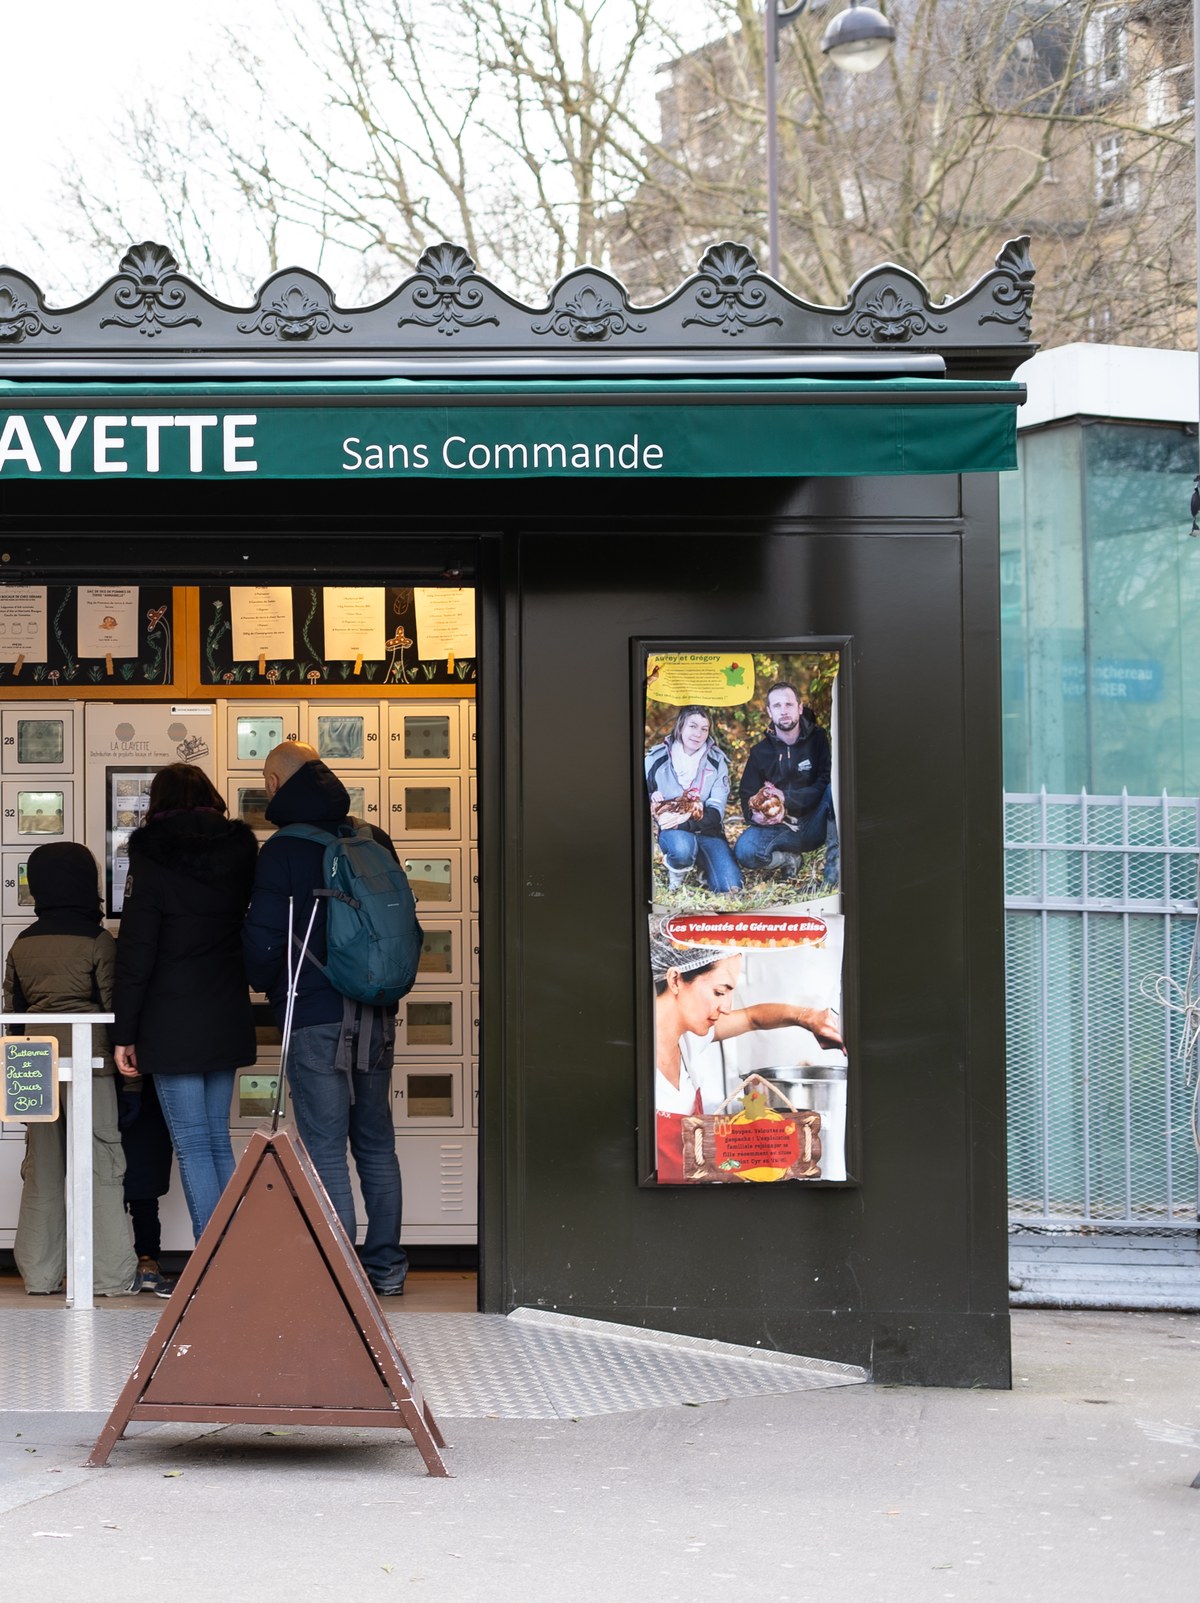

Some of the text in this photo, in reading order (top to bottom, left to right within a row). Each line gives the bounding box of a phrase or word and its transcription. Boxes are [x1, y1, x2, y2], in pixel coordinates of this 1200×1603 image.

[342, 434, 664, 470] Sans Commande
[4, 737, 14, 745] 28
[286, 733, 297, 741] 49
[366, 733, 377, 742] 50
[390, 733, 401, 742] 51
[111, 742, 149, 751] LA CLAYETTE
[4, 809, 15, 817] 32
[367, 804, 378, 813] 54
[392, 804, 402, 813] 55
[4, 880, 15, 888] 36
[669, 924, 687, 932] Les
[689, 922, 734, 932] Veloutés
[735, 922, 748, 931] de
[749, 922, 786, 931] Gérard
[788, 923, 798, 931] et
[393, 1090, 404, 1099] 71
